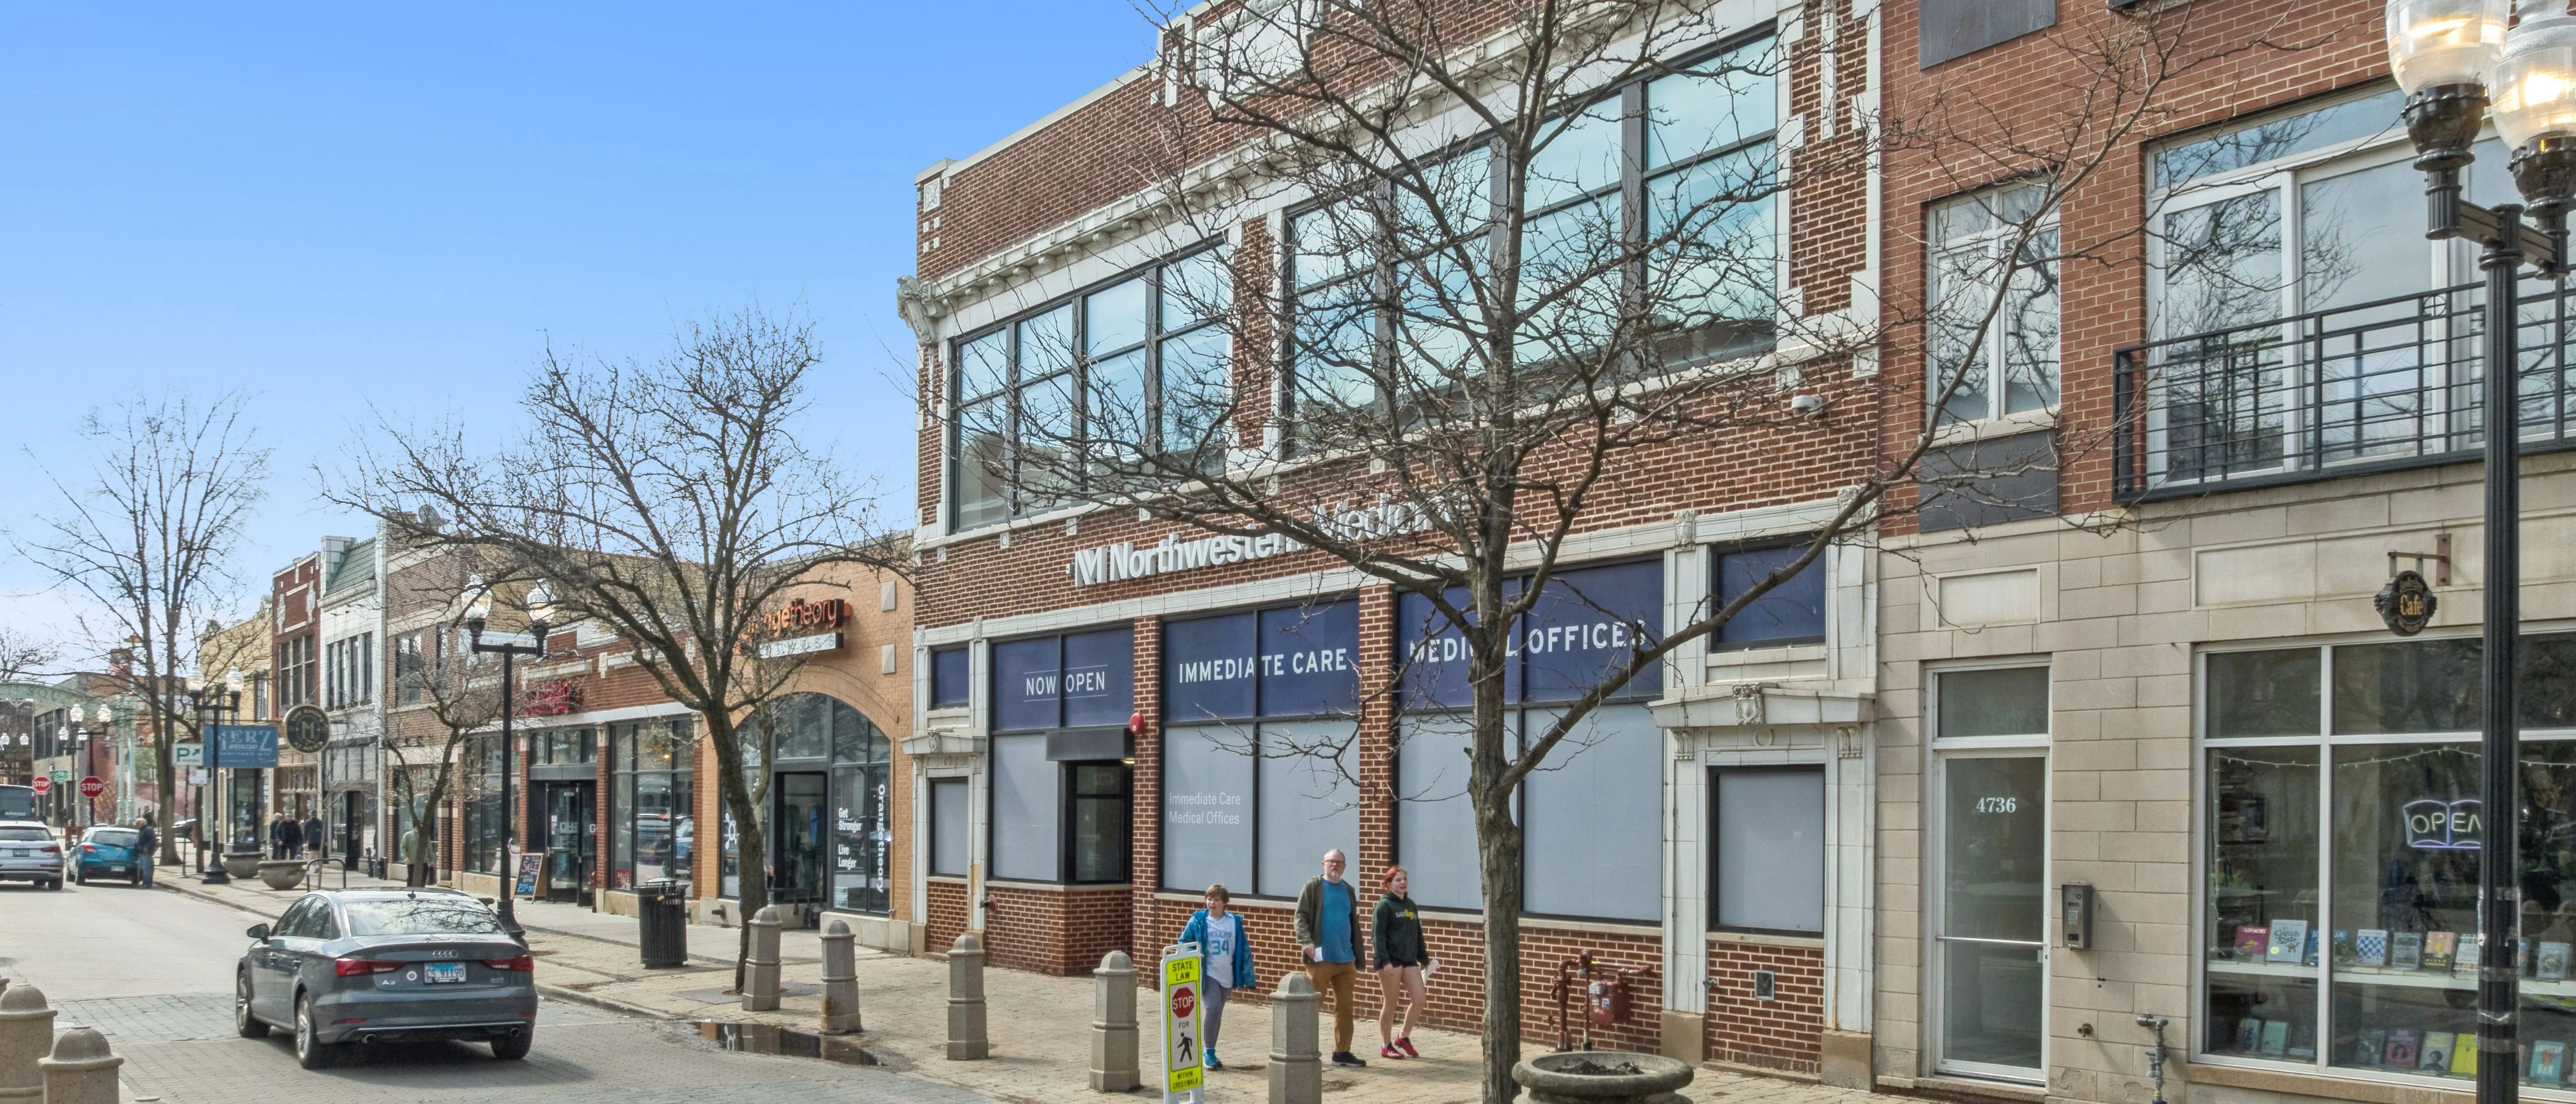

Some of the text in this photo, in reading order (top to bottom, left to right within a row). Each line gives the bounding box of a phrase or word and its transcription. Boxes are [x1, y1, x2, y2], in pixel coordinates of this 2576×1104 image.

[2400, 594, 2423, 615] Cafe
[737, 598, 841, 637] ngetheory
[1409, 633, 1518, 664] MEDIL
[1179, 648, 1347, 683] IMMEDIATE CARE
[1026, 671, 1105, 696] NOW OPEN
[81, 783, 103, 791] STOP
[1169, 792, 1241, 805] Immediate Care
[1976, 797, 2016, 813] 4736
[838, 807, 849, 819] Get
[1169, 811, 1240, 824] Medical Offices
[838, 820, 862, 833] Stronger
[876, 784, 885, 893] Orangetheory
[838, 844, 850, 855] Live
[521, 861, 540, 873] SALE
[838, 857, 857, 870] Longer
[1211, 940, 1229, 955] 34
[440, 968, 464, 978] 91190
[1173, 961, 1193, 972] STATE
[1176, 972, 1190, 981] LAW
[1173, 996, 1194, 1010] STOP
[1177, 1071, 1193, 1080] WITHIN
[1173, 1078, 1199, 1089] CROSSWALK
